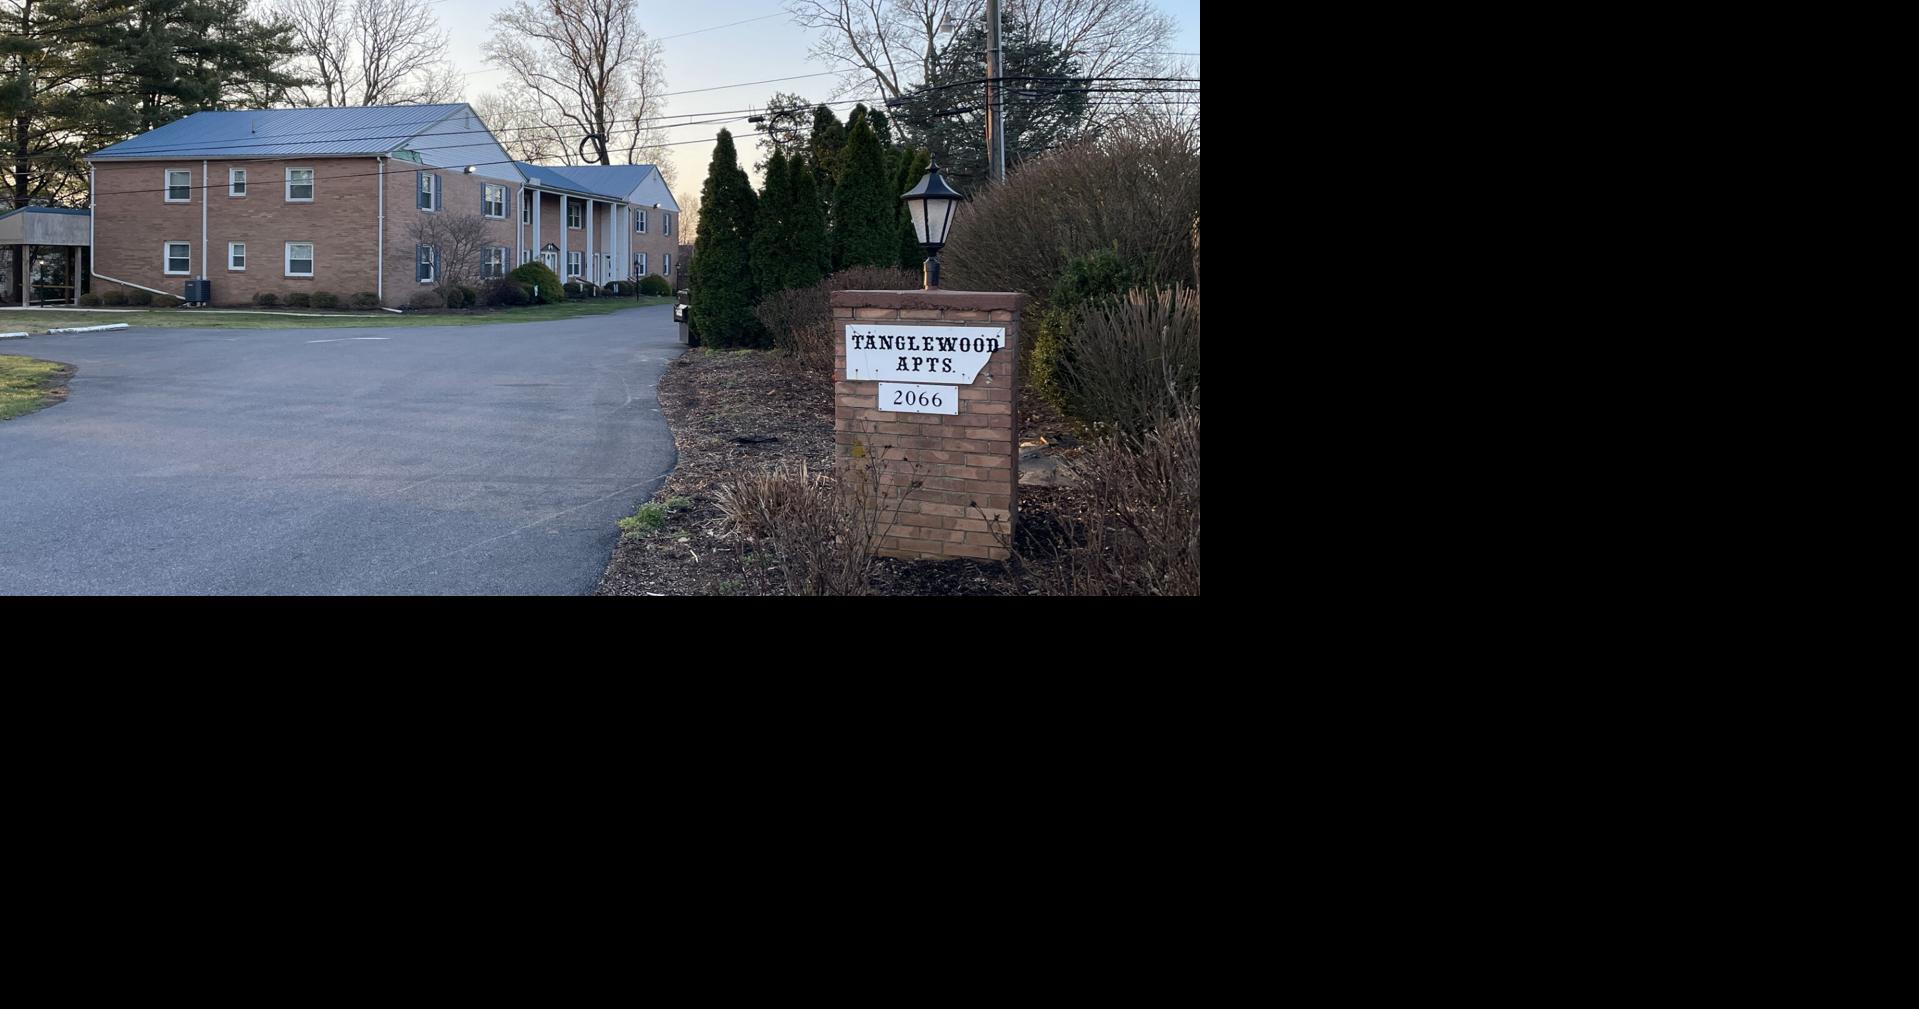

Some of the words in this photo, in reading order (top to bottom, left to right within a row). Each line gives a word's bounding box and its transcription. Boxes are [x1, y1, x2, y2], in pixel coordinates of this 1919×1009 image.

[851, 334, 1000, 353] TANGLEWOOD
[896, 356, 956, 373] APTS.
[893, 389, 943, 407] 2066
